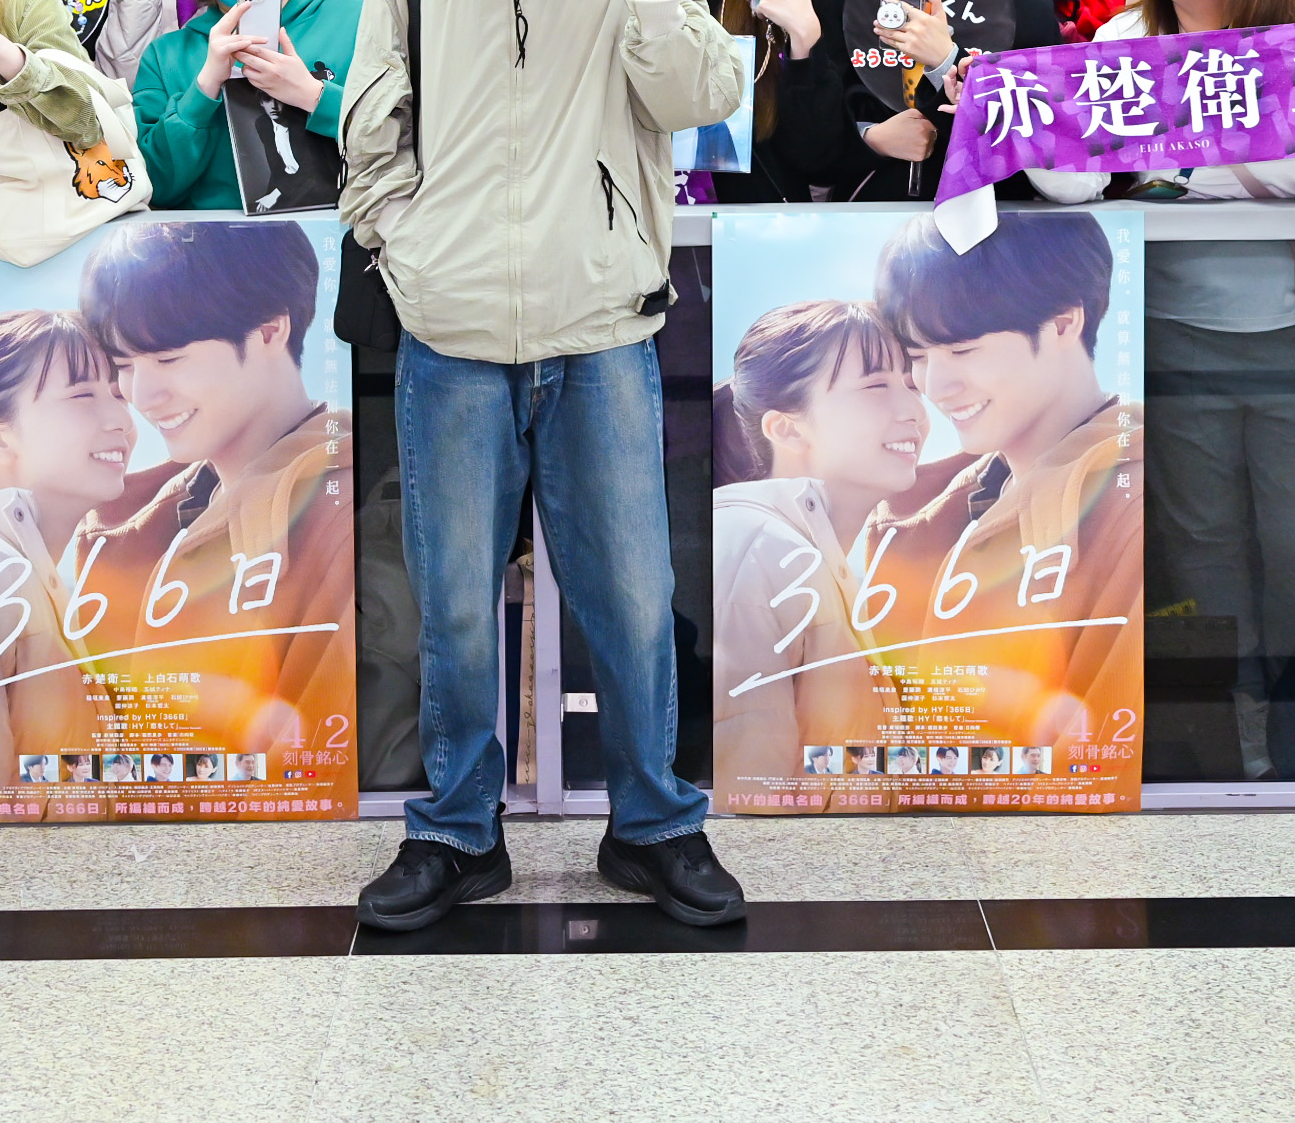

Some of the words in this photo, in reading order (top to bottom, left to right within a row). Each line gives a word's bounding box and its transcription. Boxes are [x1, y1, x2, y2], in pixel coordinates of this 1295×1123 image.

[1139, 141, 1165, 155] EIJI
[1168, 138, 1211, 153] AKASO
[769, 519, 1072, 654] 366日
[97, 713, 129, 722] inspired
[883, 706, 915, 714] inspired
[1066, 708, 1137, 743] 4/2
[283, 750, 349, 766] 刻骨銘心
[1068, 744, 1135, 760] 刻骨銘心
